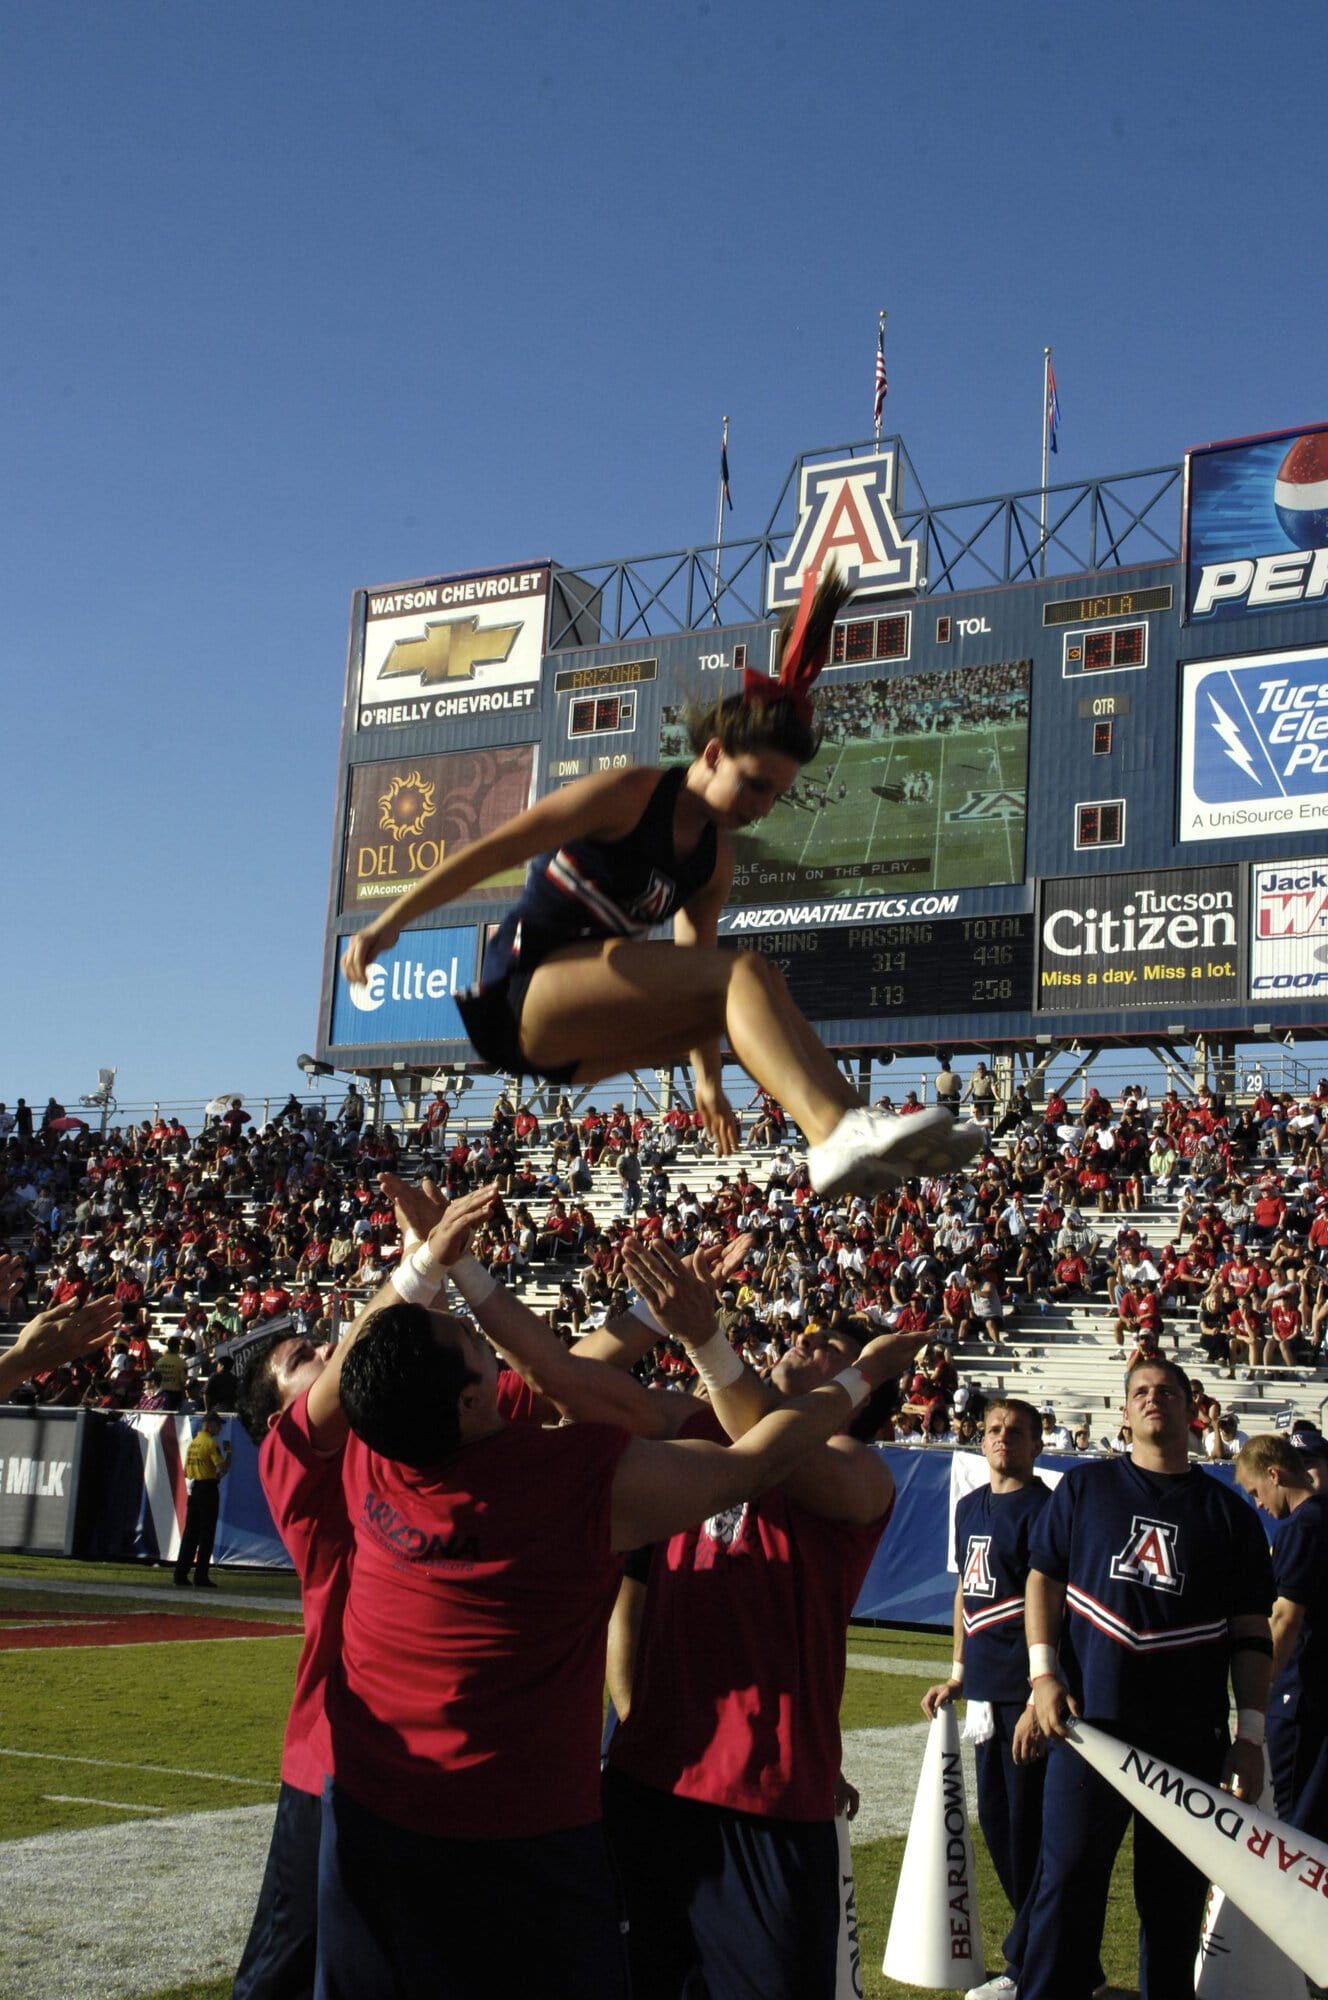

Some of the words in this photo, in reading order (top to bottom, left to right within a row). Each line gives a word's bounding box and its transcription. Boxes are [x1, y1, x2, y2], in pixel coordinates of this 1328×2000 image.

[371, 589, 437, 615] WATSON
[441, 573, 541, 604] CHEVROLET
[1080, 595, 1133, 621] UCLA
[957, 617, 991, 636] TOL
[699, 653, 730, 671] TOL
[572, 664, 641, 688] ARIZONA
[361, 702, 433, 727] O'RIELLY
[435, 689, 535, 717] CHEVROLET
[1093, 698, 1115, 715] QTR
[559, 761, 580, 776] DWN
[599, 756, 611, 771] TO
[612, 754, 627, 769] GO
[1192, 813, 1204, 829] A
[1209, 805, 1294, 827] UniSource
[357, 845, 398, 878] DEL
[759, 873, 796, 884] GAIN
[805, 870, 824, 879] ON
[835, 866, 862, 877] THE
[730, 895, 959, 929] ARIZONAATHLETICS.COM
[1135, 889, 1233, 914] Tucson
[849, 925, 933, 948] PASSING
[961, 917, 1025, 941] TOTAL
[1043, 904, 1237, 956] Citizen
[350, 956, 459, 1012] alltel
[1041, 970, 1081, 986] Miss
[1087, 971, 1098, 985] a
[1102, 968, 1138, 985] day.
[1144, 964, 1186, 980] Miss
[1191, 966, 1202, 979] a
[1207, 962, 1236, 978] lot.
[1247, 1074, 1263, 1092] 29
[6, 1457, 66, 1496] MILK
[962, 1535, 996, 1598] A
[1110, 1515, 1186, 1595] A
